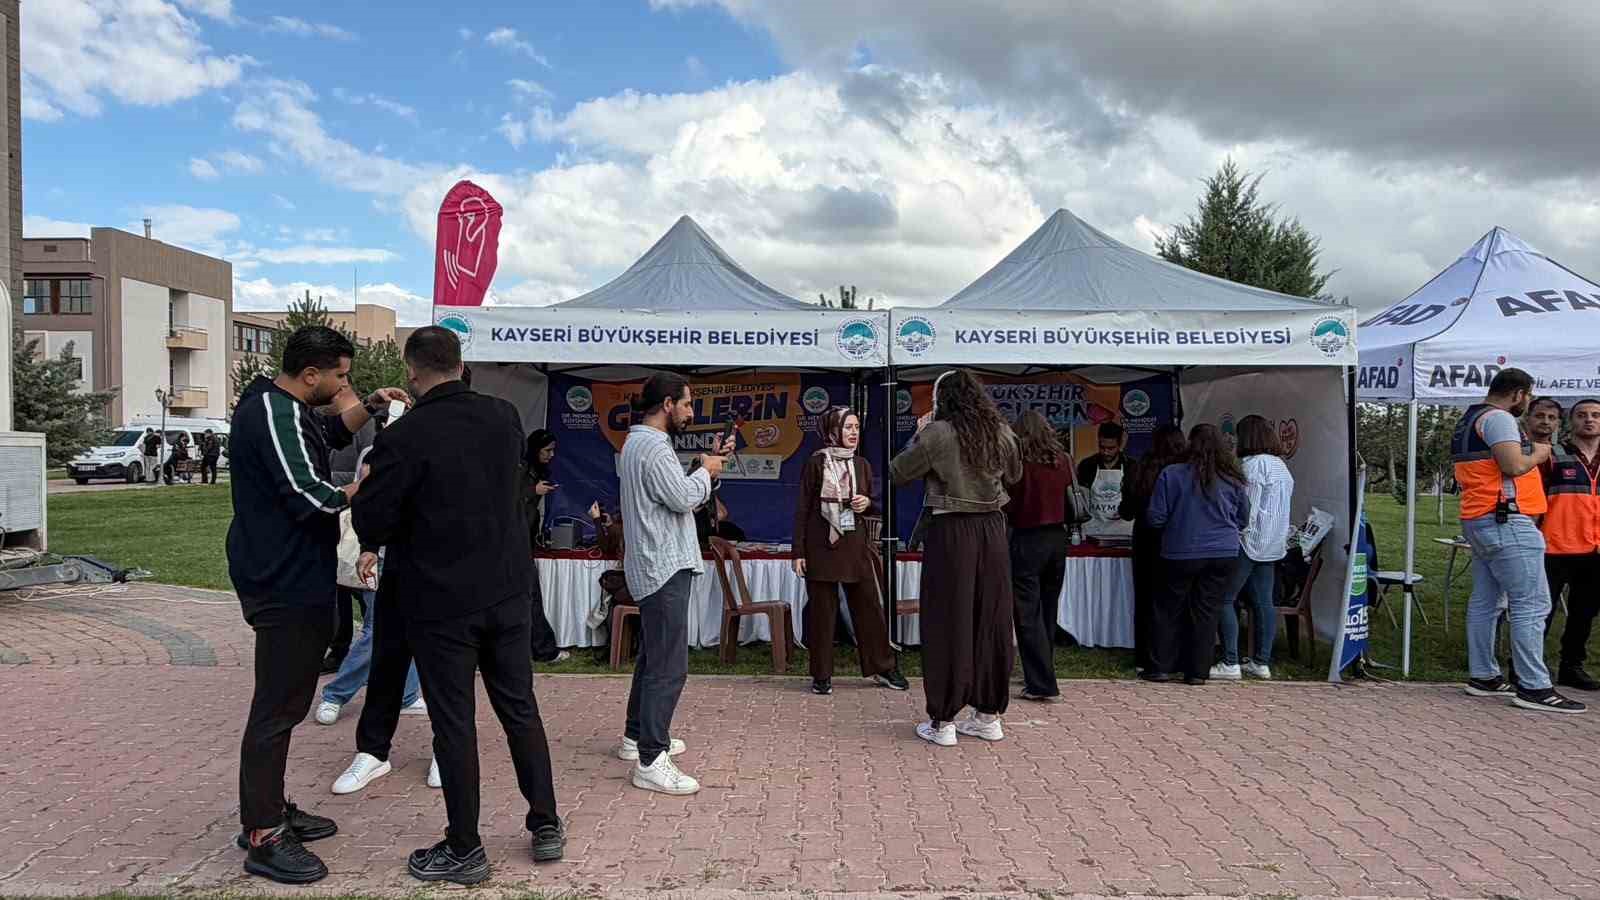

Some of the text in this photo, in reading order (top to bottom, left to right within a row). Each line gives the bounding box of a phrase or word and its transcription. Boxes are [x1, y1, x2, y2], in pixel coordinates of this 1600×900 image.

[1495, 288, 1600, 316] AFA
[491, 326, 572, 343] KAYSERİ
[578, 326, 702, 346] BÜYÜKŞEHİR
[708, 328, 819, 346] BELEDİYESİ
[955, 327, 1037, 344] KAYSERİ
[1043, 327, 1170, 347] BÜYÜKŞEHİR
[1176, 328, 1291, 345] BELEDİYESİ
[1357, 365, 1400, 389] AFAD
[1428, 364, 1500, 388] AFAD
[1549, 378, 1584, 390] AFET
